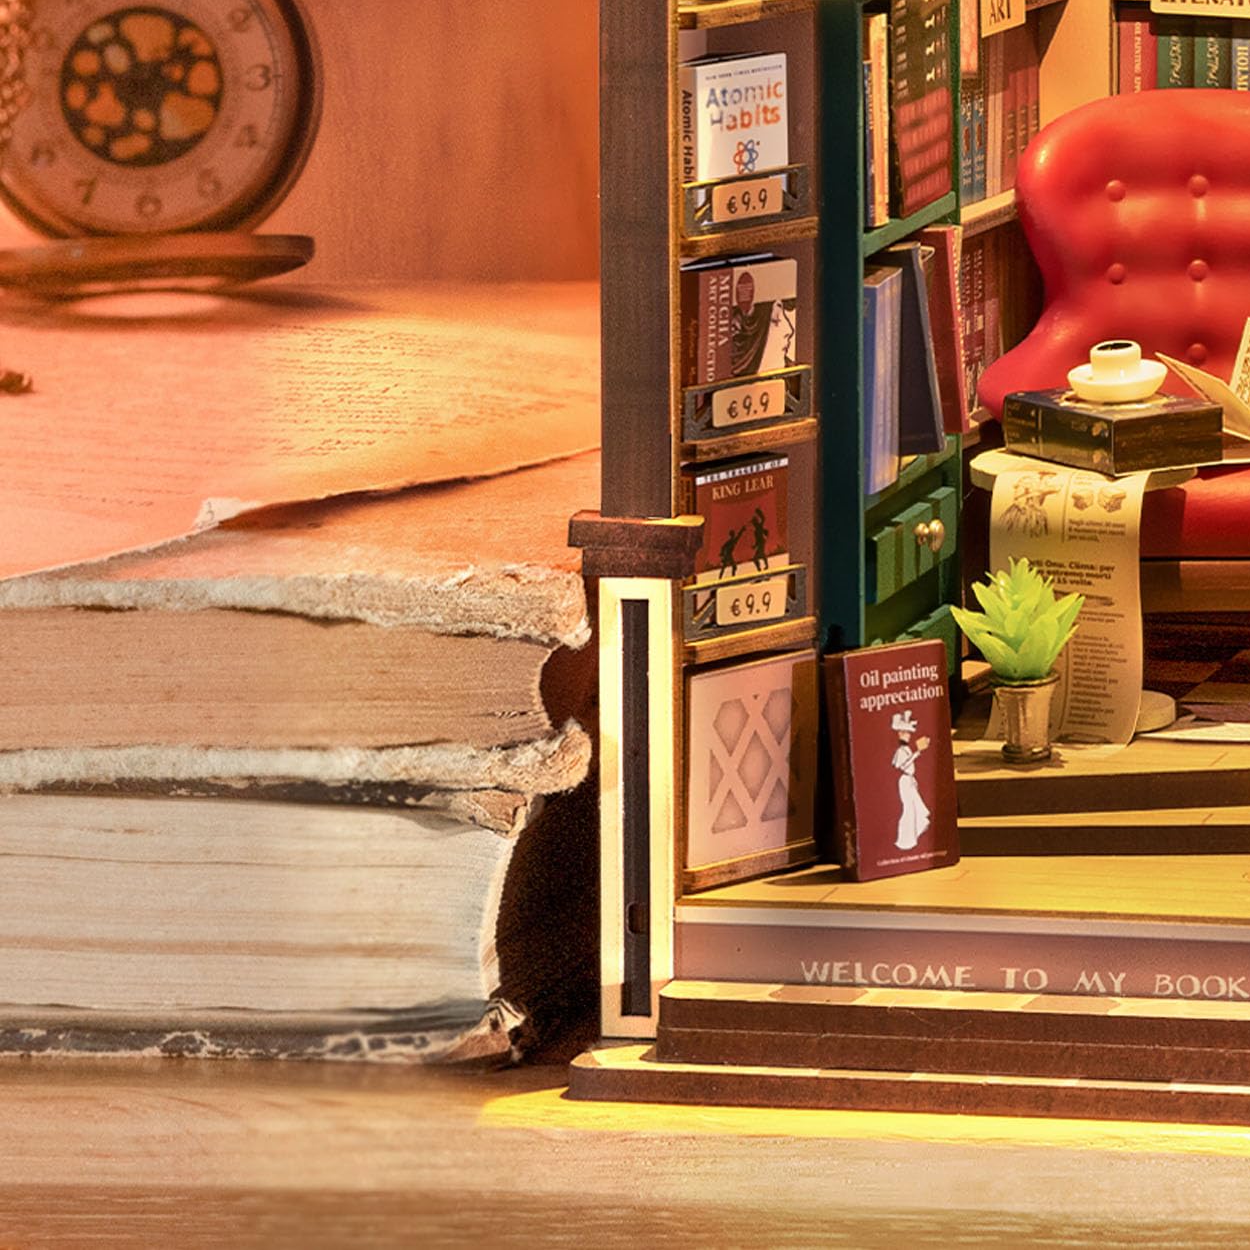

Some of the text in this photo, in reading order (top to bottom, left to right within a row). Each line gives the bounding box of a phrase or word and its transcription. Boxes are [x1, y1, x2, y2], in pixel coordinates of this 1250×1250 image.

[706, 78, 783, 108] Atomic
[682, 90, 694, 143] Atomic
[711, 104, 781, 131] Habits
[726, 188, 768, 215] €9.9
[708, 275, 718, 297] ART
[718, 274, 731, 347] MUCHA
[726, 391, 770, 420] €9.9
[711, 475, 774, 500] KING LEAR
[730, 591, 772, 617] €9.9
[859, 664, 939, 689] Oil painting
[859, 682, 945, 712] appreciation
[800, 960, 976, 989] WELCOME
[1001, 967, 1049, 991] TO
[1072, 971, 1127, 995] MY
[1154, 974, 1250, 999] BOOK
